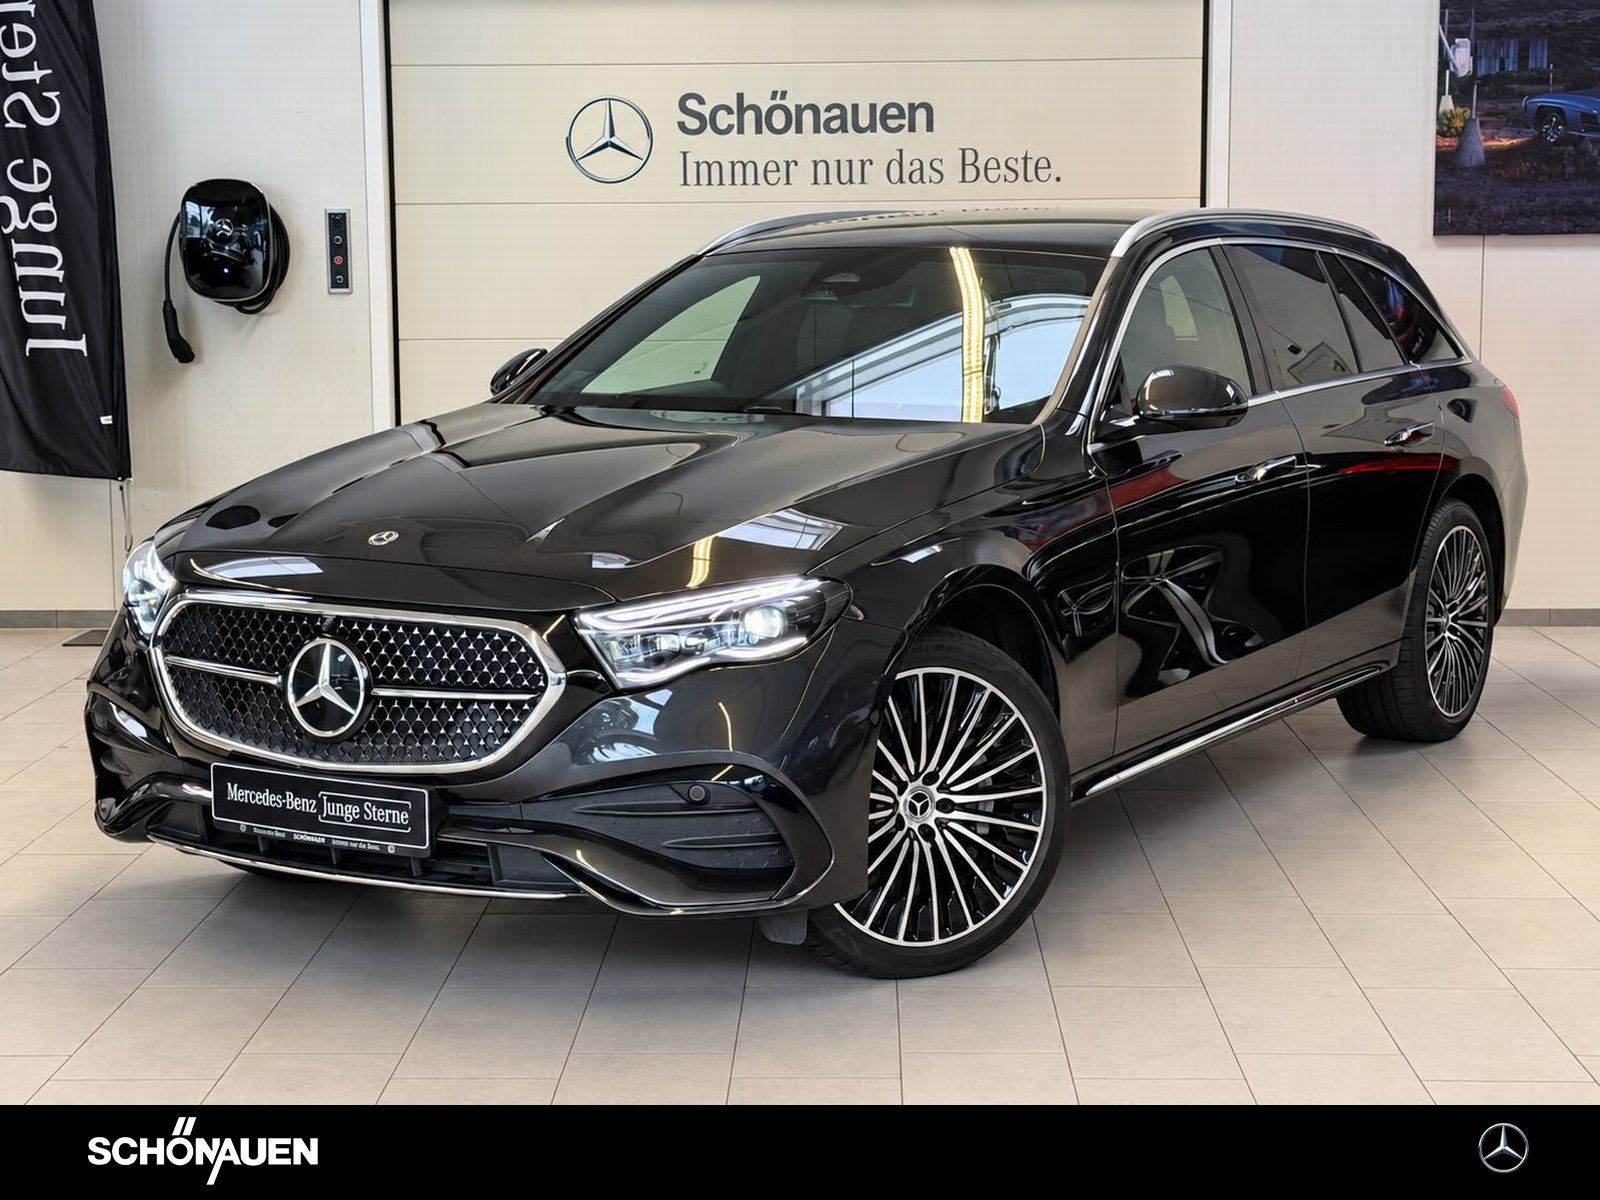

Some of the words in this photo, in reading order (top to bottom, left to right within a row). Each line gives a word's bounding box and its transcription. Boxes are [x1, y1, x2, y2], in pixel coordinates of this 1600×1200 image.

[677, 90, 935, 136] Schönauen
[679, 151, 798, 187] Immer
[811, 158, 874, 186] nur
[886, 149, 944, 185] das
[958, 148, 1063, 184] Beste.
[226, 782, 317, 814] Mercedes-Benz
[322, 796, 360, 823] Junge
[364, 801, 410, 825] Sterne
